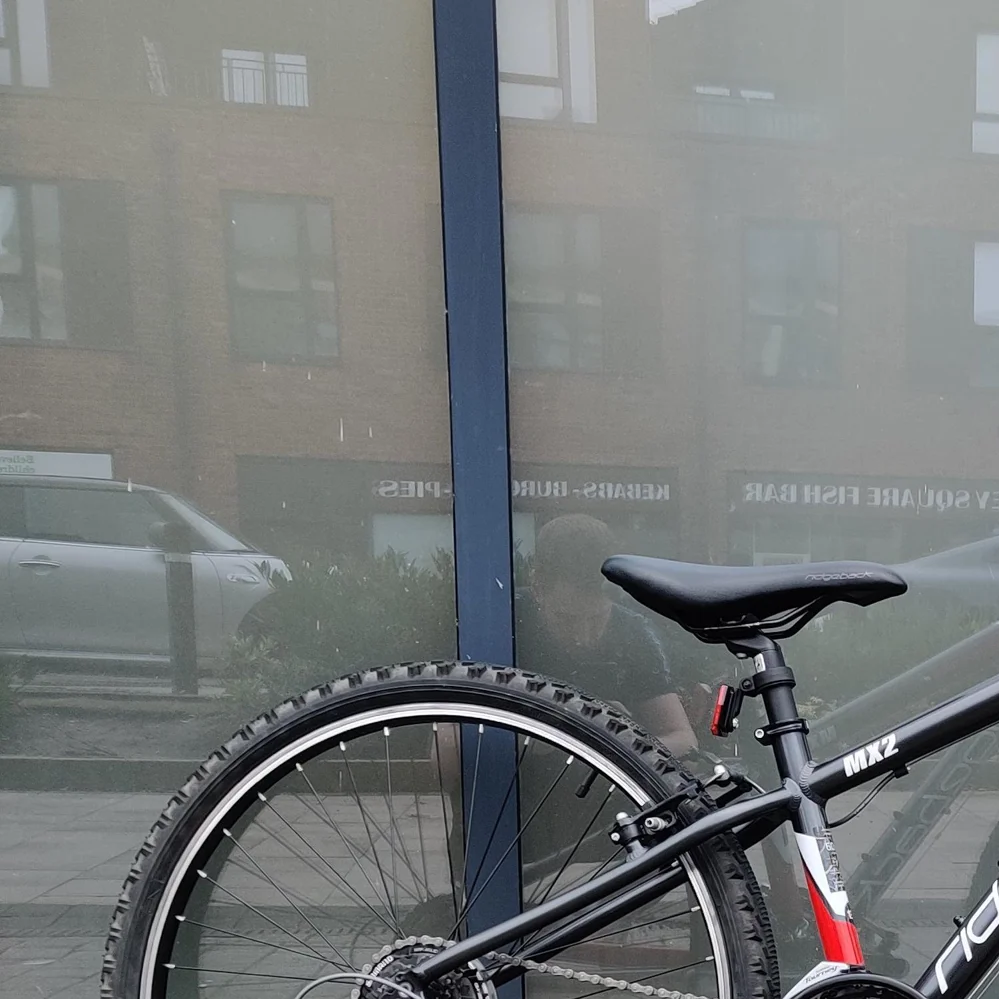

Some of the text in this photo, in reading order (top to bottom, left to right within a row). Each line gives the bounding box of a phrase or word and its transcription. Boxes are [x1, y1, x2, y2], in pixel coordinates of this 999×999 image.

[804, 571, 875, 582] ridgeback
[842, 733, 899, 778] MX2
[365, 955, 394, 988] SIMANO
